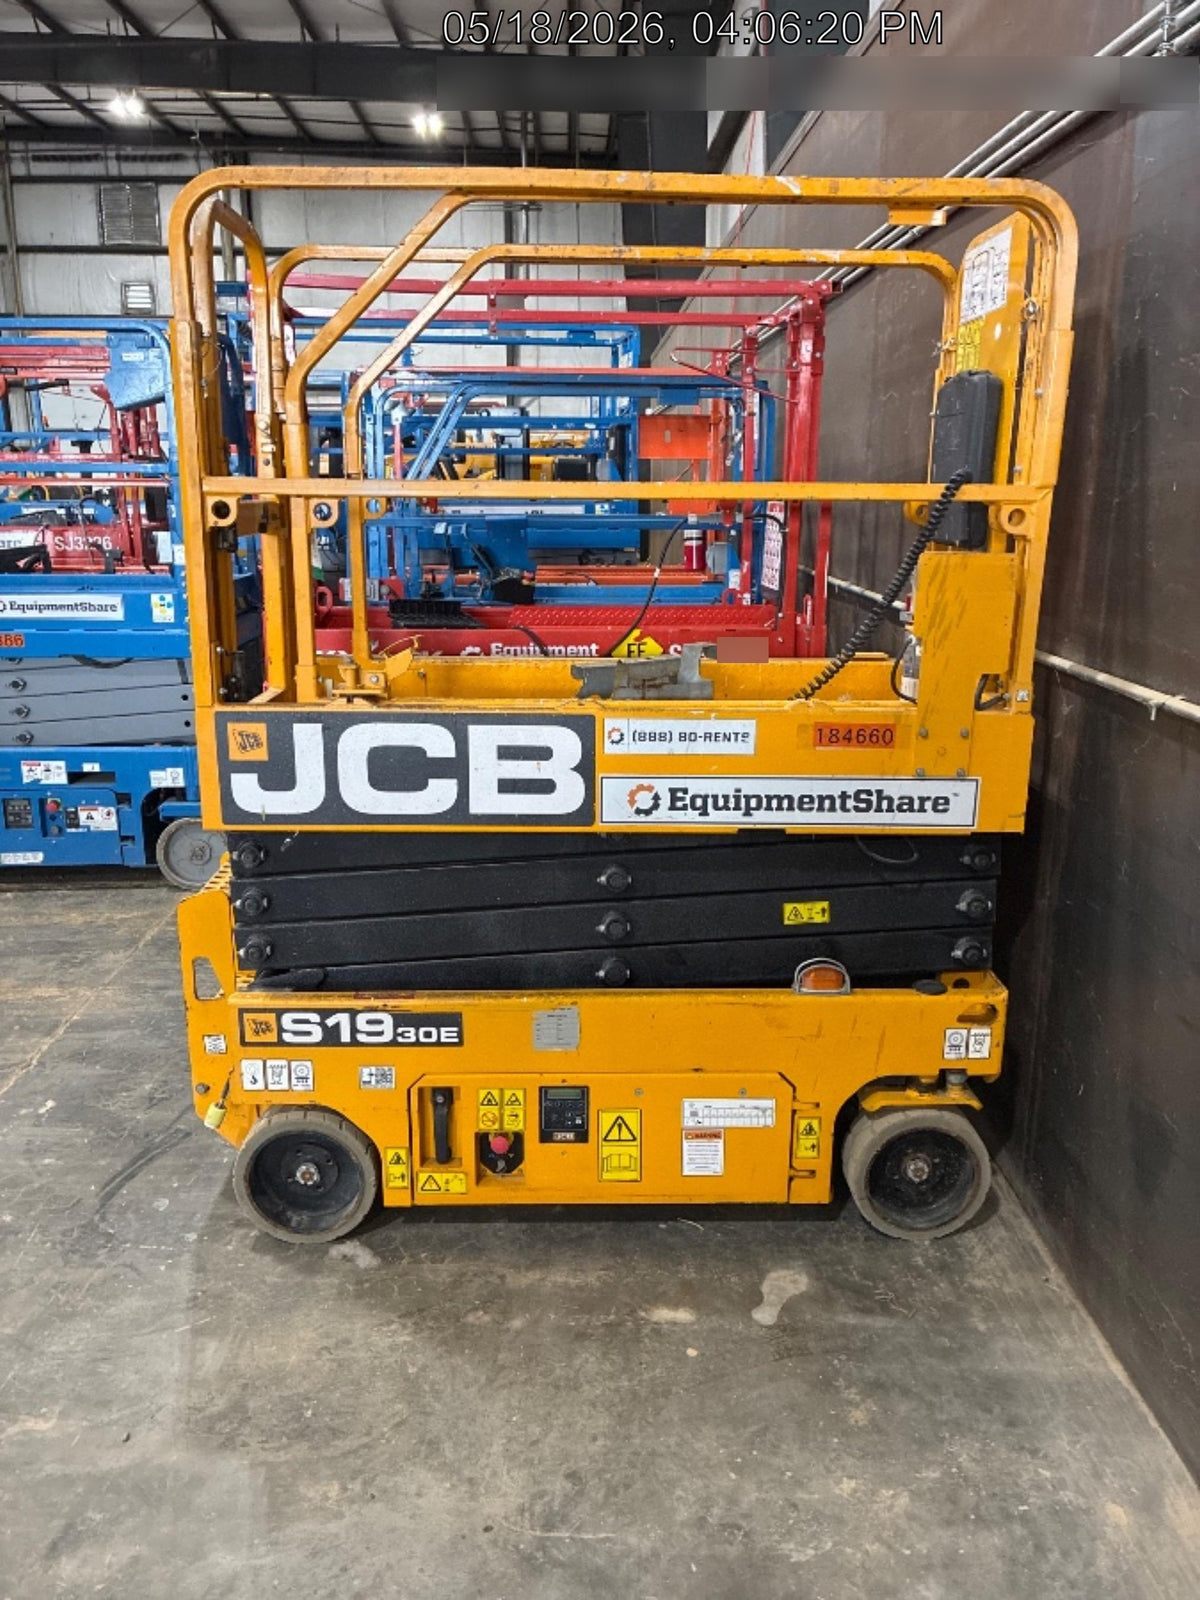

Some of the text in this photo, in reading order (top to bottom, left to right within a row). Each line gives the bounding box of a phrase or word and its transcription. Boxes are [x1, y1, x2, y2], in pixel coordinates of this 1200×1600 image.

[8, 600, 118, 613] EquipmentShare
[632, 729, 673, 744] (888)
[817, 728, 895, 746] 184660
[230, 722, 586, 815] JCB
[667, 787, 951, 817] EquipmentShare
